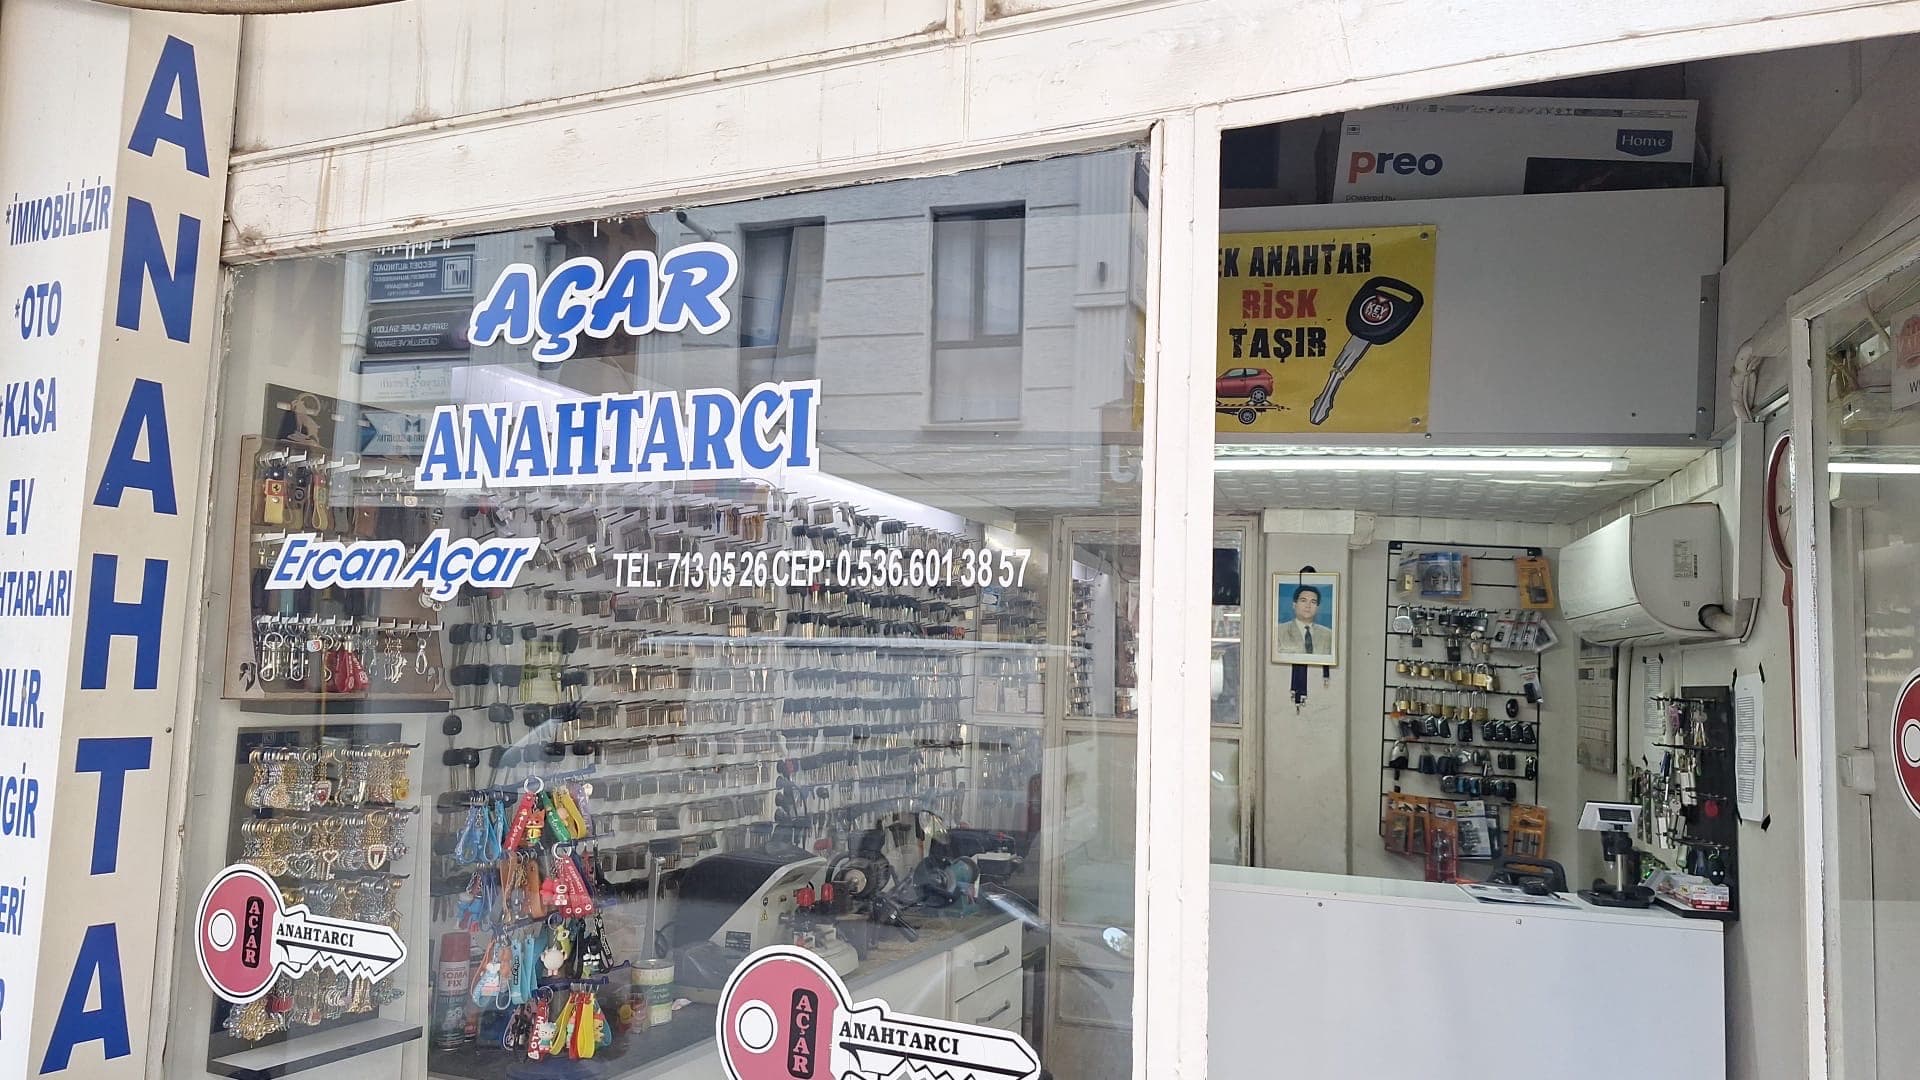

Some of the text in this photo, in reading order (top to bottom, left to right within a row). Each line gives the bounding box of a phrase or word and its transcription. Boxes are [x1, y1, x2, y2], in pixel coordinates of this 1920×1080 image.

[1348, 151, 1443, 183] preo
[1621, 134, 1667, 147] Home
[1219, 243, 1372, 277] K ANAHTAR
[20, 280, 62, 340] OTO
[471, 246, 734, 360] AÇAR
[1241, 283, 1319, 319] RİSK
[1229, 327, 1327, 363] TAŞIR
[3, 377, 57, 438] KASA
[417, 383, 817, 487] ANAHTARCI
[6, 478, 35, 535] EV
[270, 534, 535, 597] Ercan Açar
[613, 548, 1031, 588] TEL: 713 05 26 CEP: 0.536.601 38 57
[0, 668, 45, 728] ILIR.
[244, 900, 262, 964] AÇAR
[276, 922, 355, 948] ANAHTARCI
[792, 994, 815, 1074] AÇAR
[839, 1020, 960, 1056] ANAHTARCI
